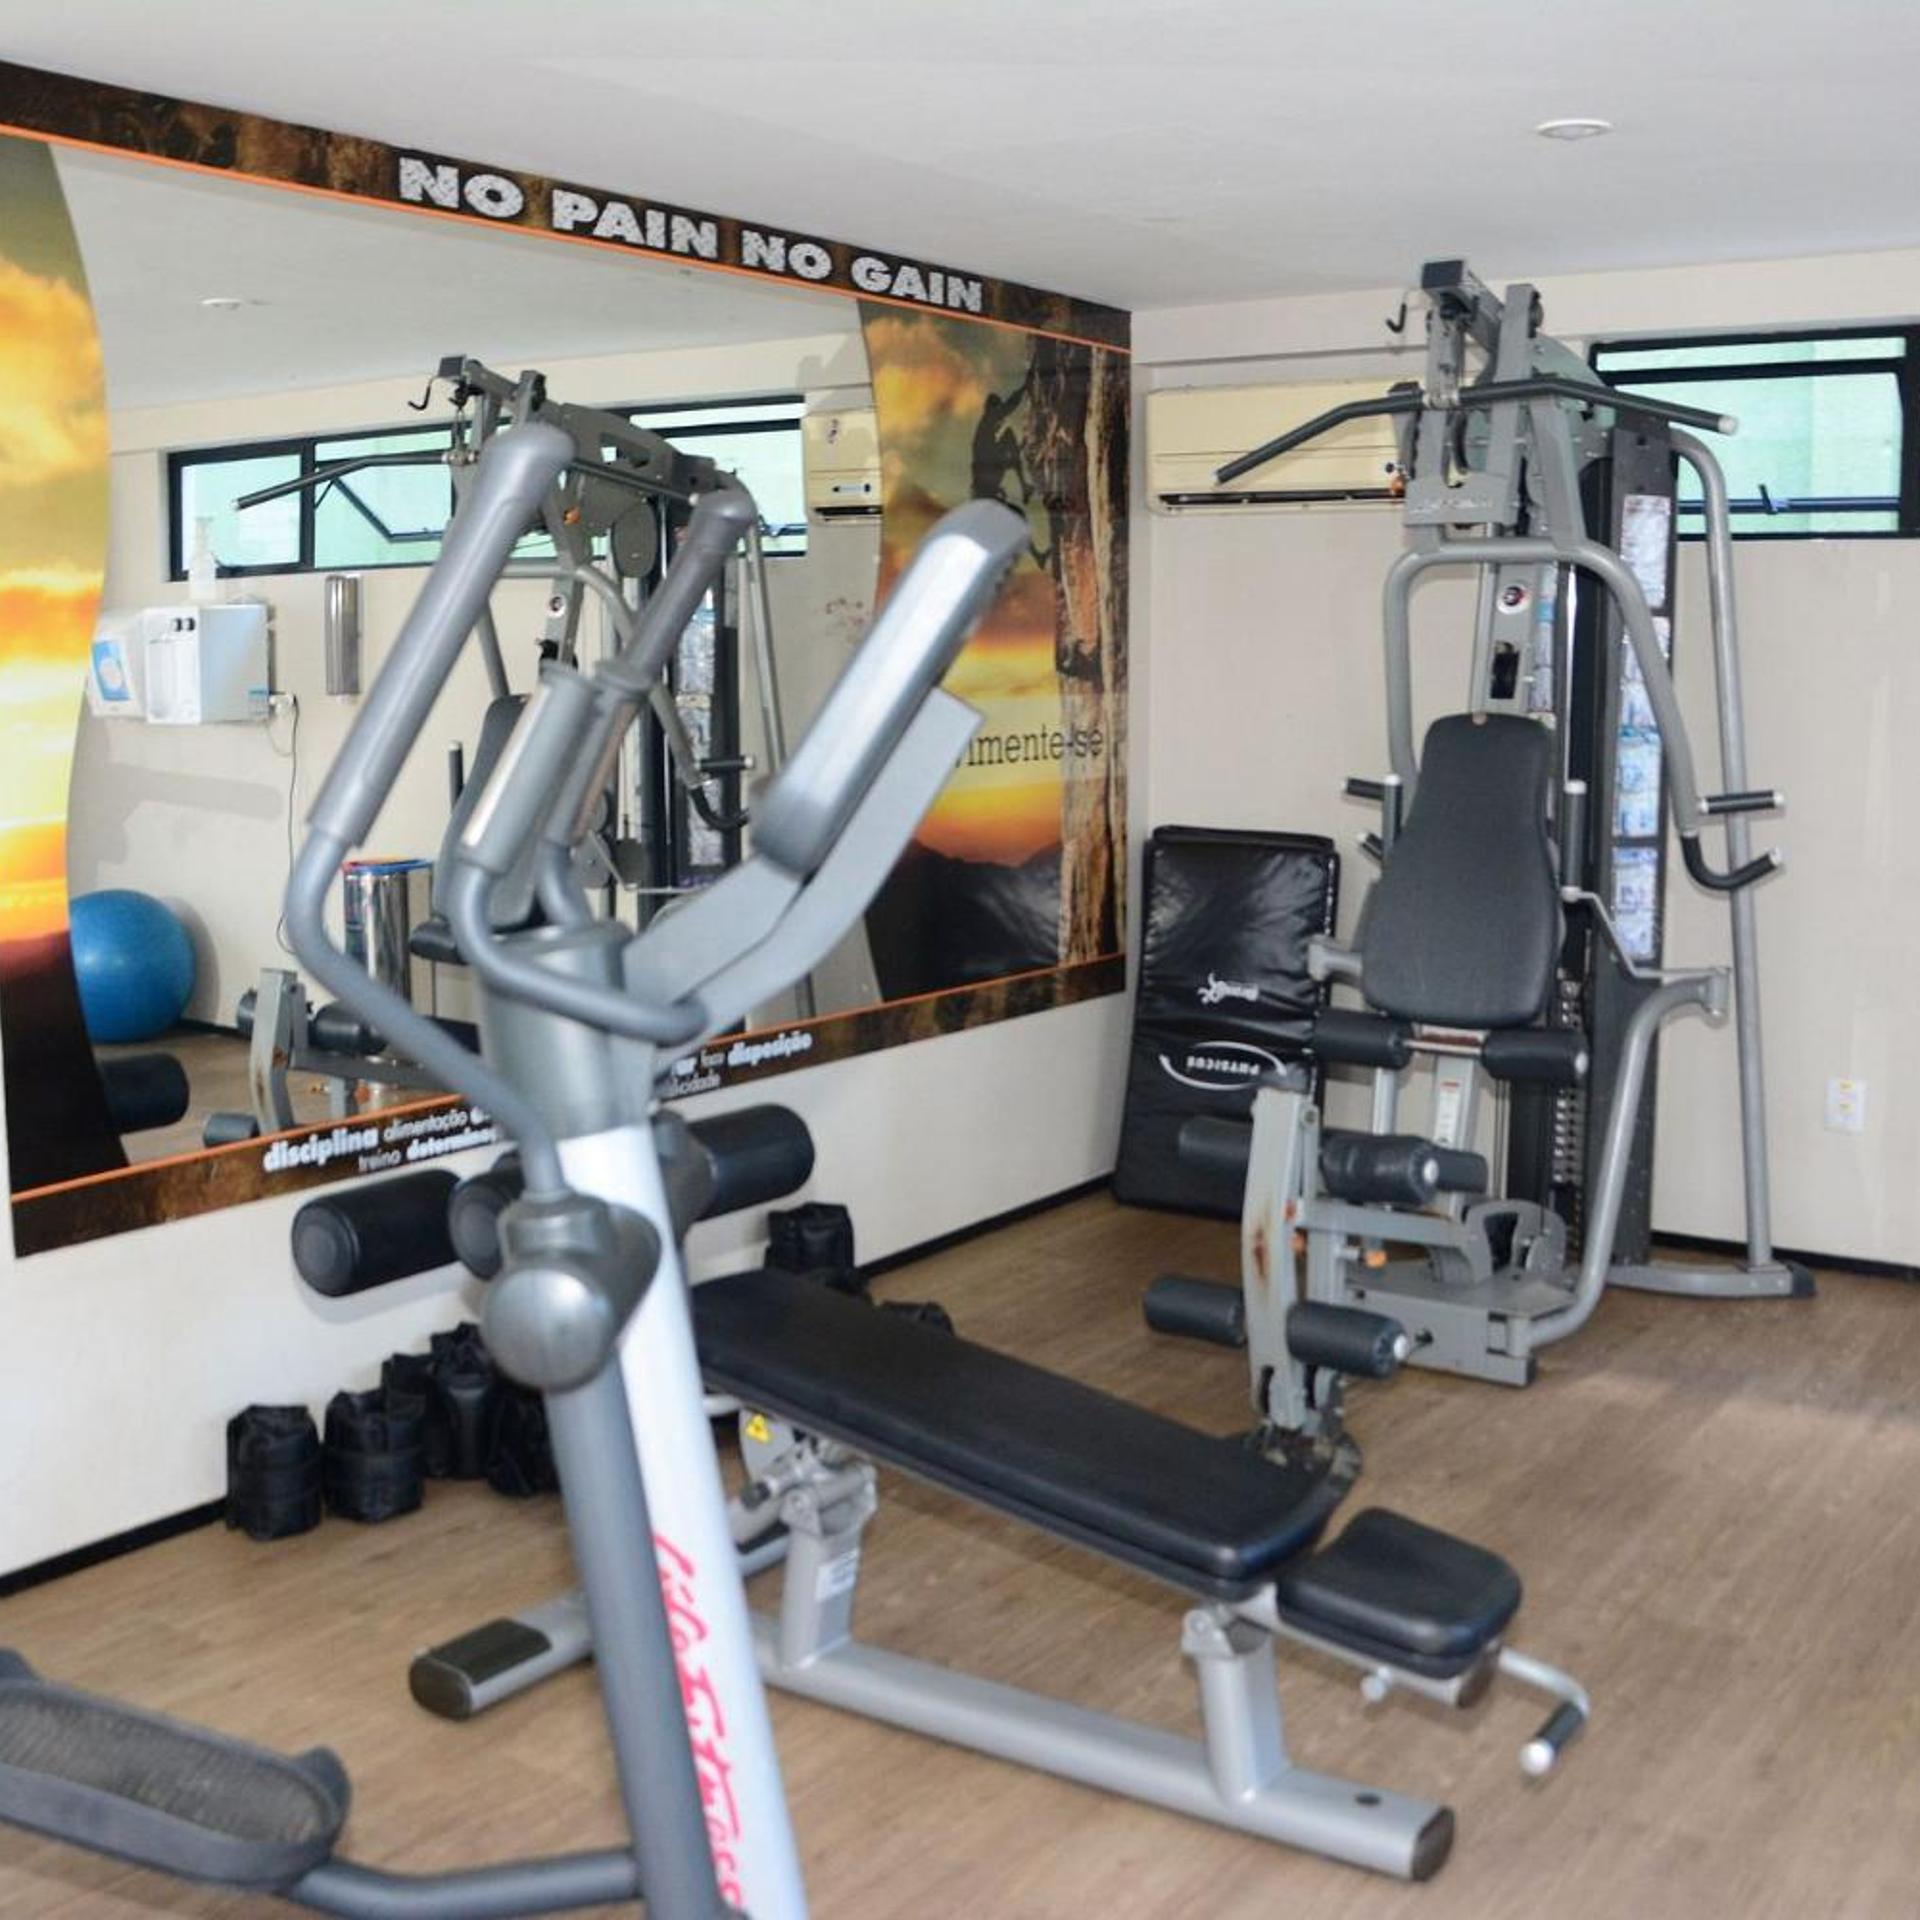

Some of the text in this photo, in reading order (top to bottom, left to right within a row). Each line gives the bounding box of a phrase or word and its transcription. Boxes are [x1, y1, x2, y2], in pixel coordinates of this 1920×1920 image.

[399, 156, 983, 312] NO PAIN NO GAIN
[1186, 1055, 1261, 1076] PHYSICUS
[263, 1127, 379, 1172] disciplina
